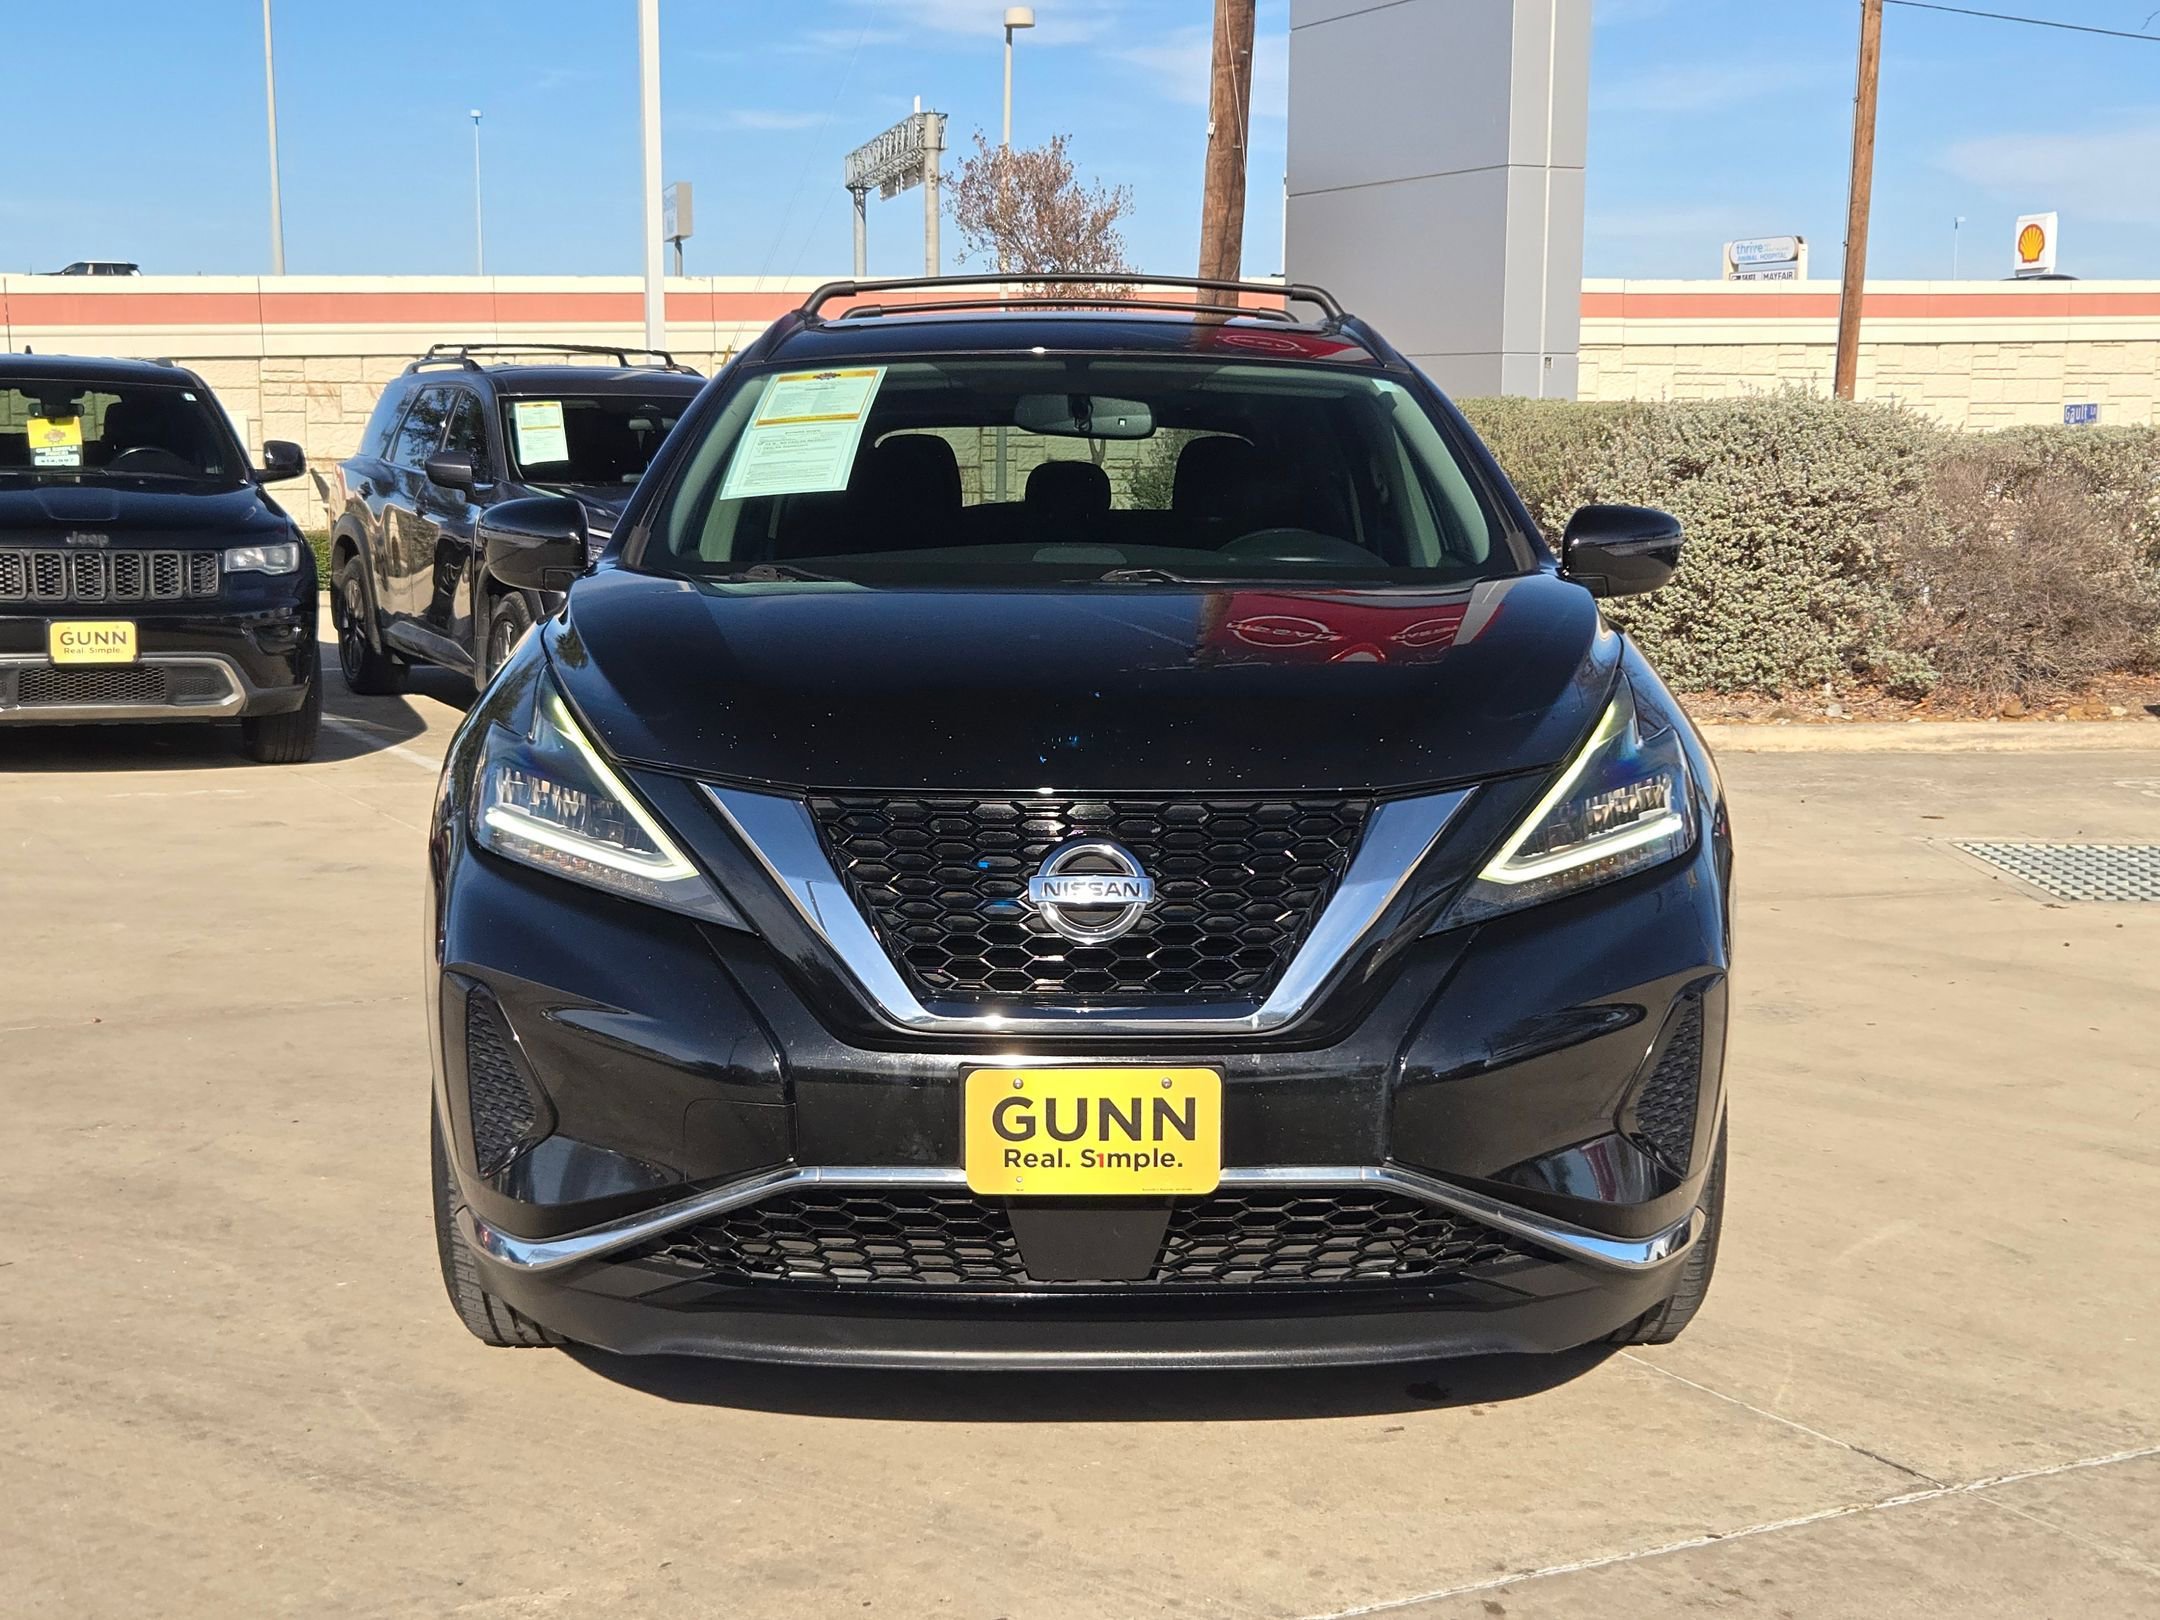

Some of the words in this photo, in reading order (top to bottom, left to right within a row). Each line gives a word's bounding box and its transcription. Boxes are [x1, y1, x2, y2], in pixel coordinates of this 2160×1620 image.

[1736, 242, 1763, 255] thrive
[1763, 271, 1793, 280] MAYFAIR
[2065, 404, 2088, 422] Gault
[66, 531, 109, 547] Jeep
[60, 631, 127, 646] GUNN
[1043, 882, 1140, 897] NISSAN
[992, 1096, 1196, 1142] GUNN
[1004, 1148, 1071, 1168] Real.
